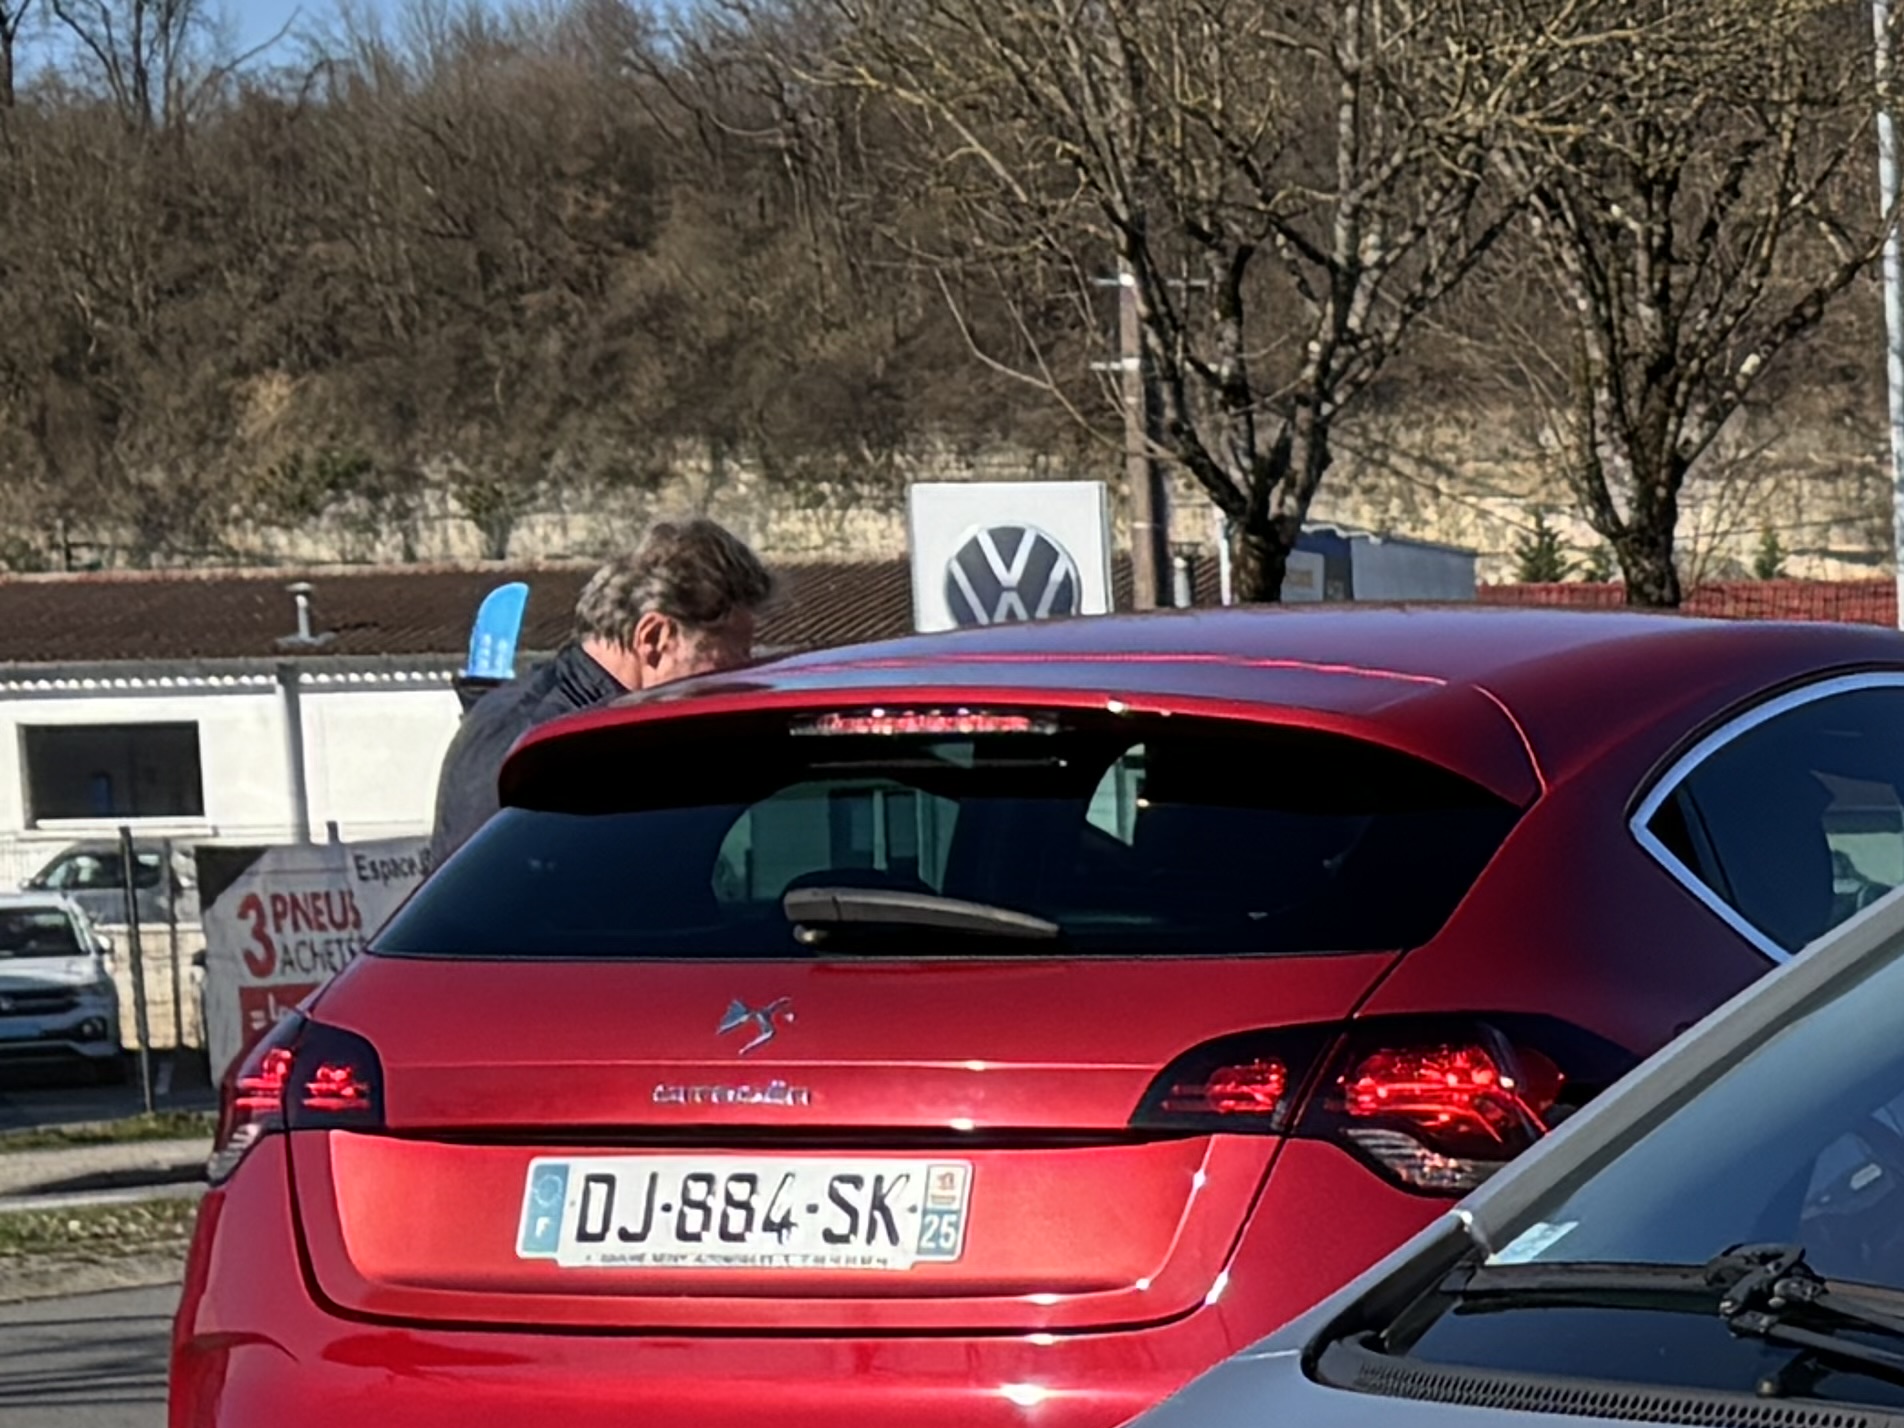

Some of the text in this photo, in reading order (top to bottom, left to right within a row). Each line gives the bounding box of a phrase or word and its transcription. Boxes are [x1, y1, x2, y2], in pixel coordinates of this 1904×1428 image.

[270, 889, 362, 934] PNEUS
[237, 892, 277, 979] 3
[920, 1213, 958, 1248] 25
